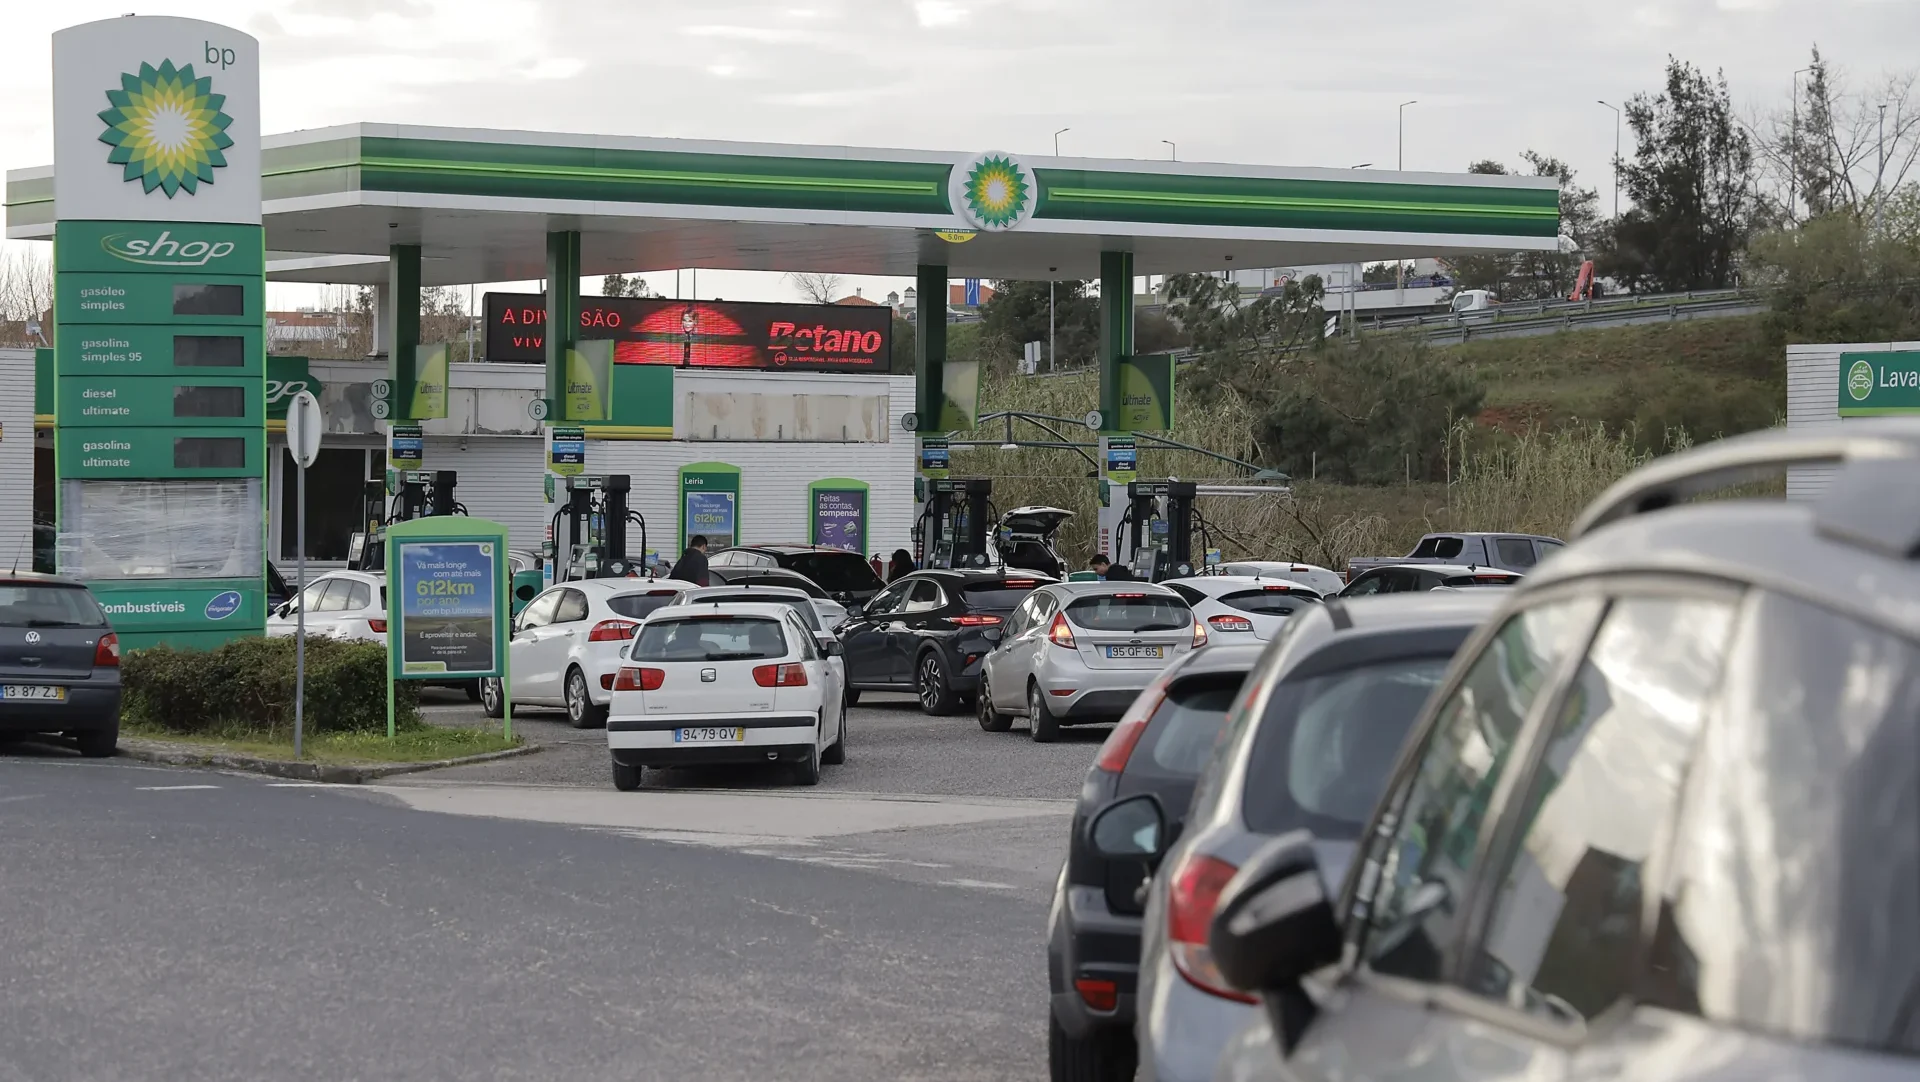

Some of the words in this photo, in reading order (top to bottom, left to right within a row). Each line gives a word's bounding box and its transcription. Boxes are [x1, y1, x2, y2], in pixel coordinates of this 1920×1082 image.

[204, 41, 235, 69] bp
[126, 231, 235, 265] shop
[80, 286, 125, 298] gasóleo
[80, 300, 125, 311] simples
[502, 308, 515, 324] A
[81, 338, 130, 350] gasolina
[81, 352, 126, 363] simples
[128, 352, 142, 361] 95
[1880, 366, 1920, 390] Lava
[82, 388, 116, 398] diesel
[374, 384, 386, 394] 10
[82, 406, 130, 415] ultimate
[376, 404, 383, 414] 8
[534, 404, 541, 415] 6
[907, 417, 913, 427] 4
[1091, 415, 1097, 425] 2
[83, 441, 131, 452] gasolina
[83, 458, 130, 467] ultimate
[684, 477, 704, 485] Leiria
[819, 493, 841, 502] Feitas
[828, 503, 854, 511] contas,
[819, 508, 860, 518] compensa!
[694, 514, 724, 523] 612km
[416, 561, 426, 569] Vá
[446, 561, 467, 569] longe
[464, 569, 482, 577] mais
[416, 580, 475, 596] 612km
